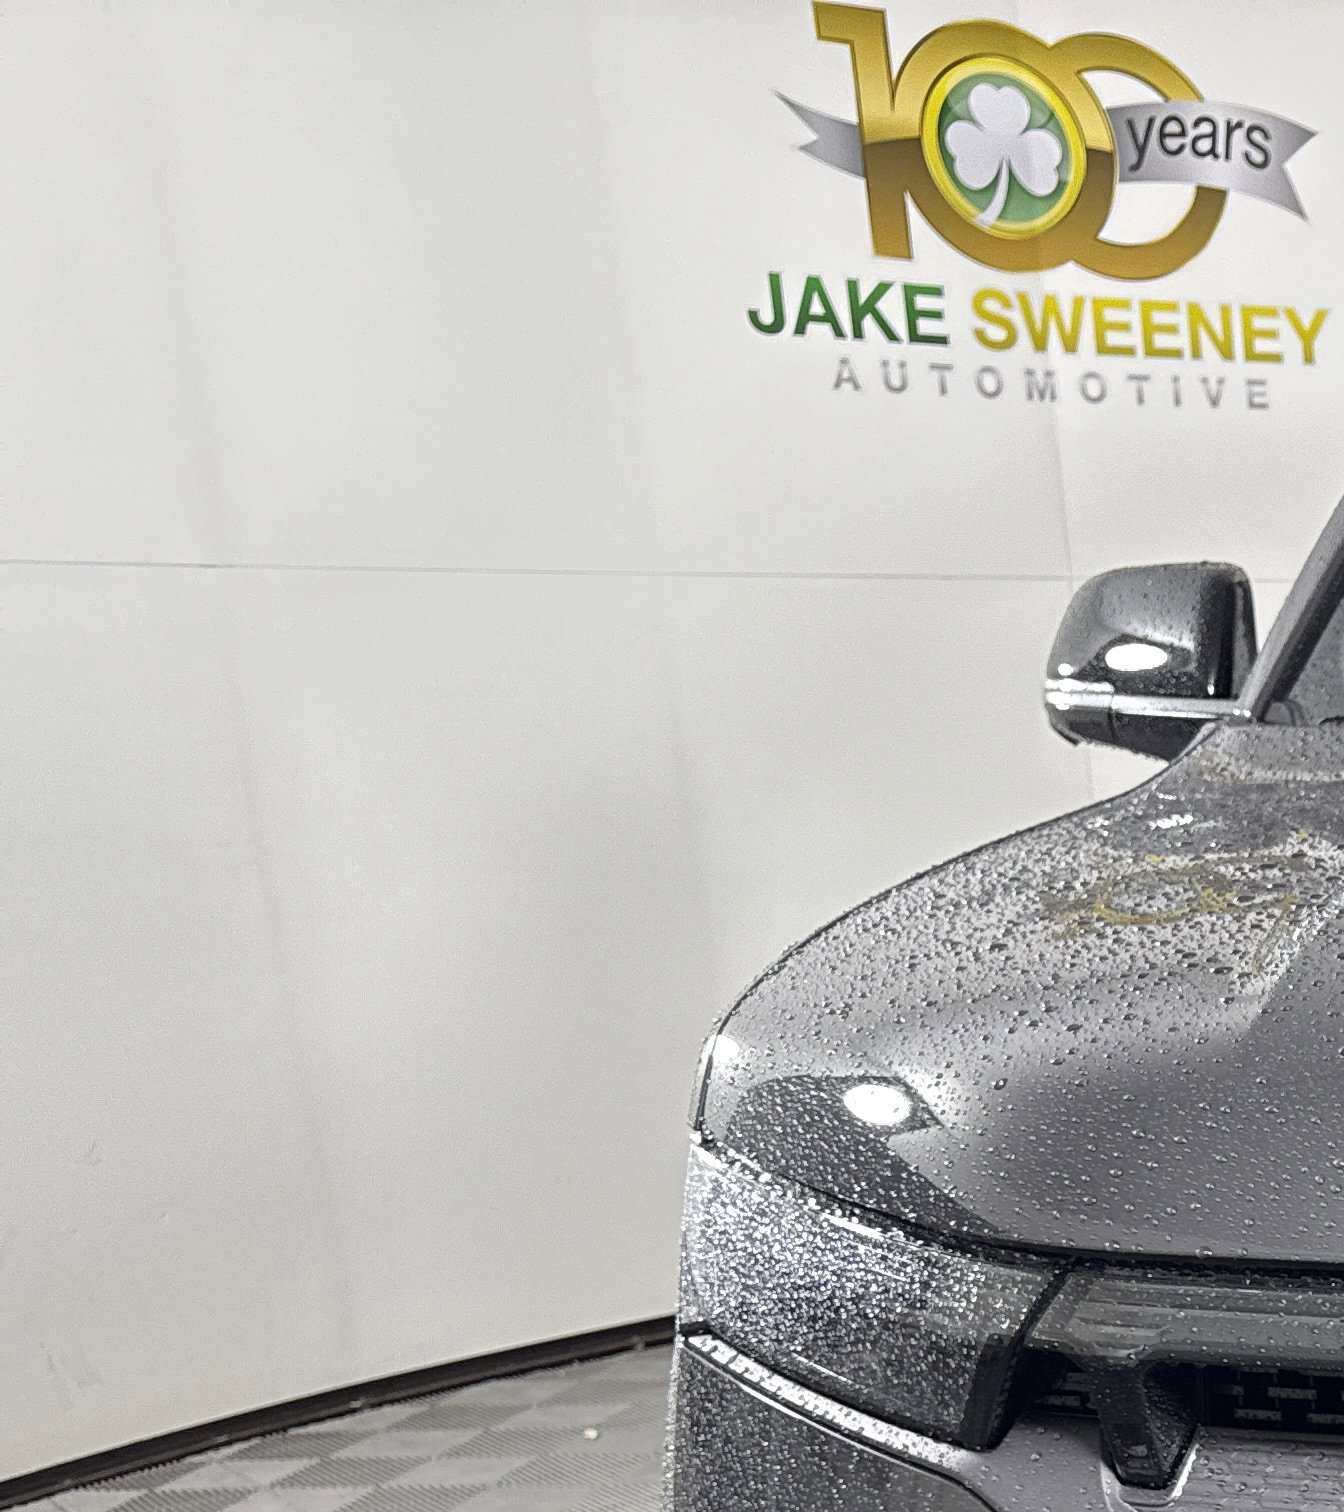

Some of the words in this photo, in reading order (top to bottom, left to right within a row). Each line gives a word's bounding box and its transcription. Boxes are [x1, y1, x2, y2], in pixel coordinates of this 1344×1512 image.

[1125, 111, 1272, 171] years
[748, 272, 950, 346] JAKE
[971, 287, 1331, 365] SWEENEY
[833, 358, 1270, 410] AUTOMOTIVE
